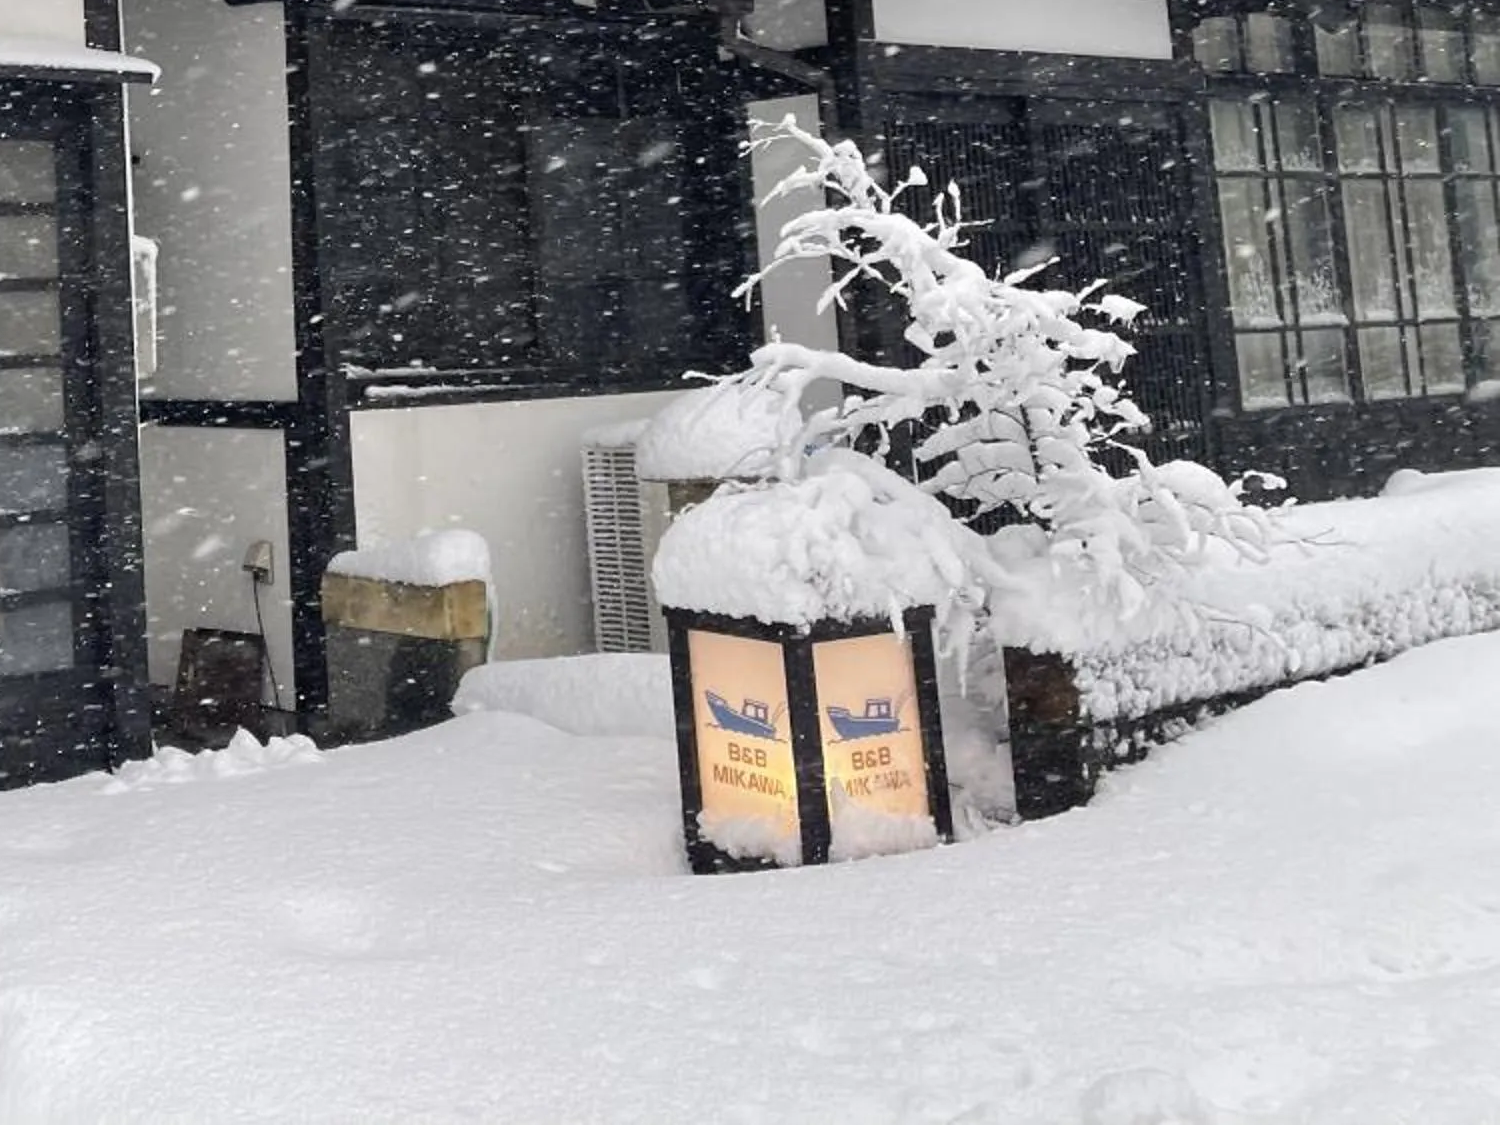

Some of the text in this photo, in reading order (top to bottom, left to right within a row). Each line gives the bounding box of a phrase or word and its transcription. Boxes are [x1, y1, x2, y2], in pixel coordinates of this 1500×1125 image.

[728, 741, 767, 768] B&B
[851, 746, 891, 771] B&B
[713, 763, 787, 799] MIKAWA
